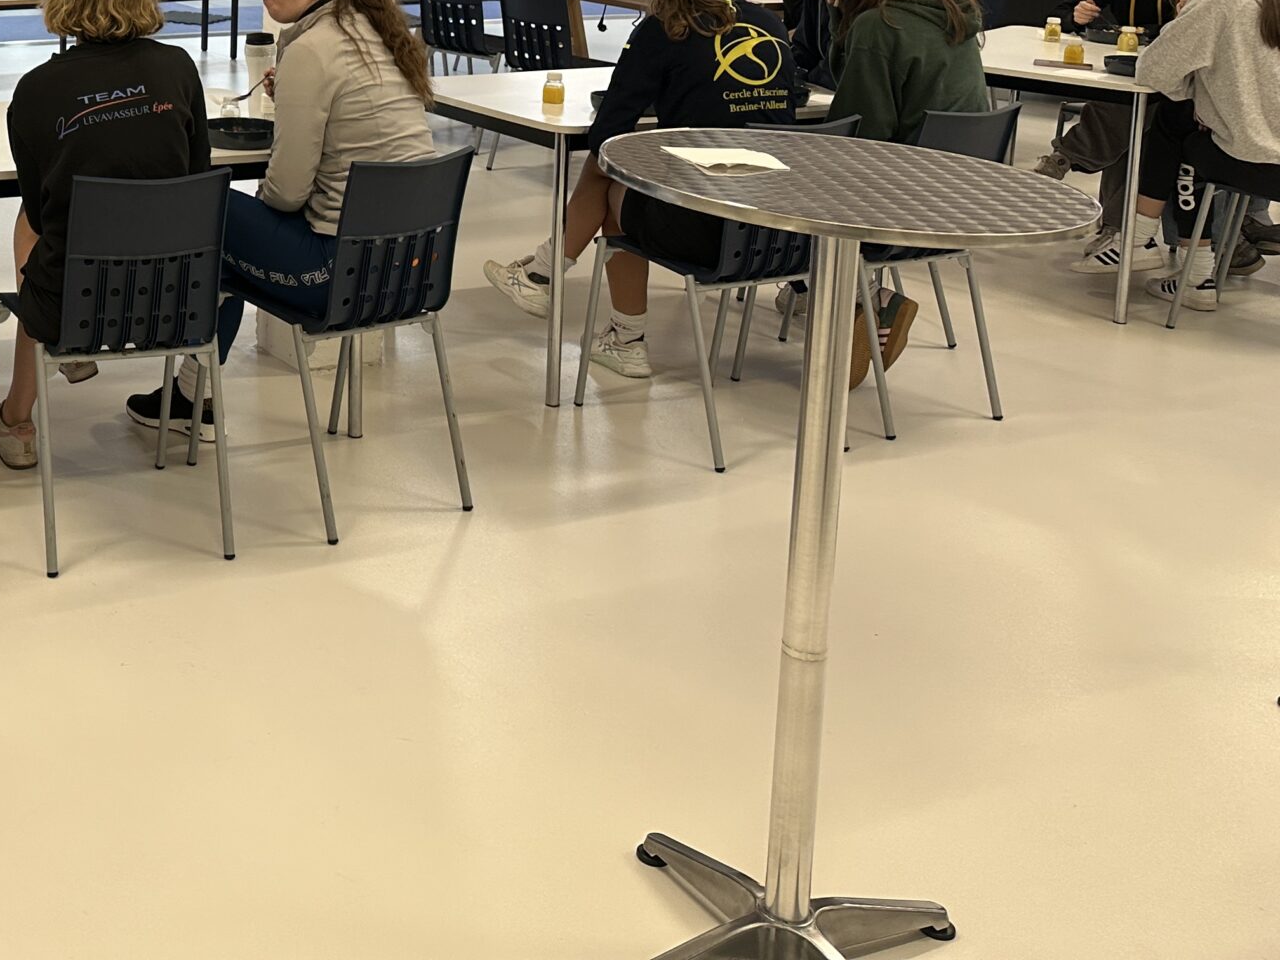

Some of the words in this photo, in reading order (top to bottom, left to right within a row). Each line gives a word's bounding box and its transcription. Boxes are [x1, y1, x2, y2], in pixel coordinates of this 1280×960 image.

[77, 85, 146, 104] TEAM
[722, 88, 751, 100] Cercle
[83, 105, 151, 126] LEVAVASSEUR
[152, 101, 174, 114] Épée
[269, 271, 298, 287] FILA
[300, 267, 330, 286] FILA
